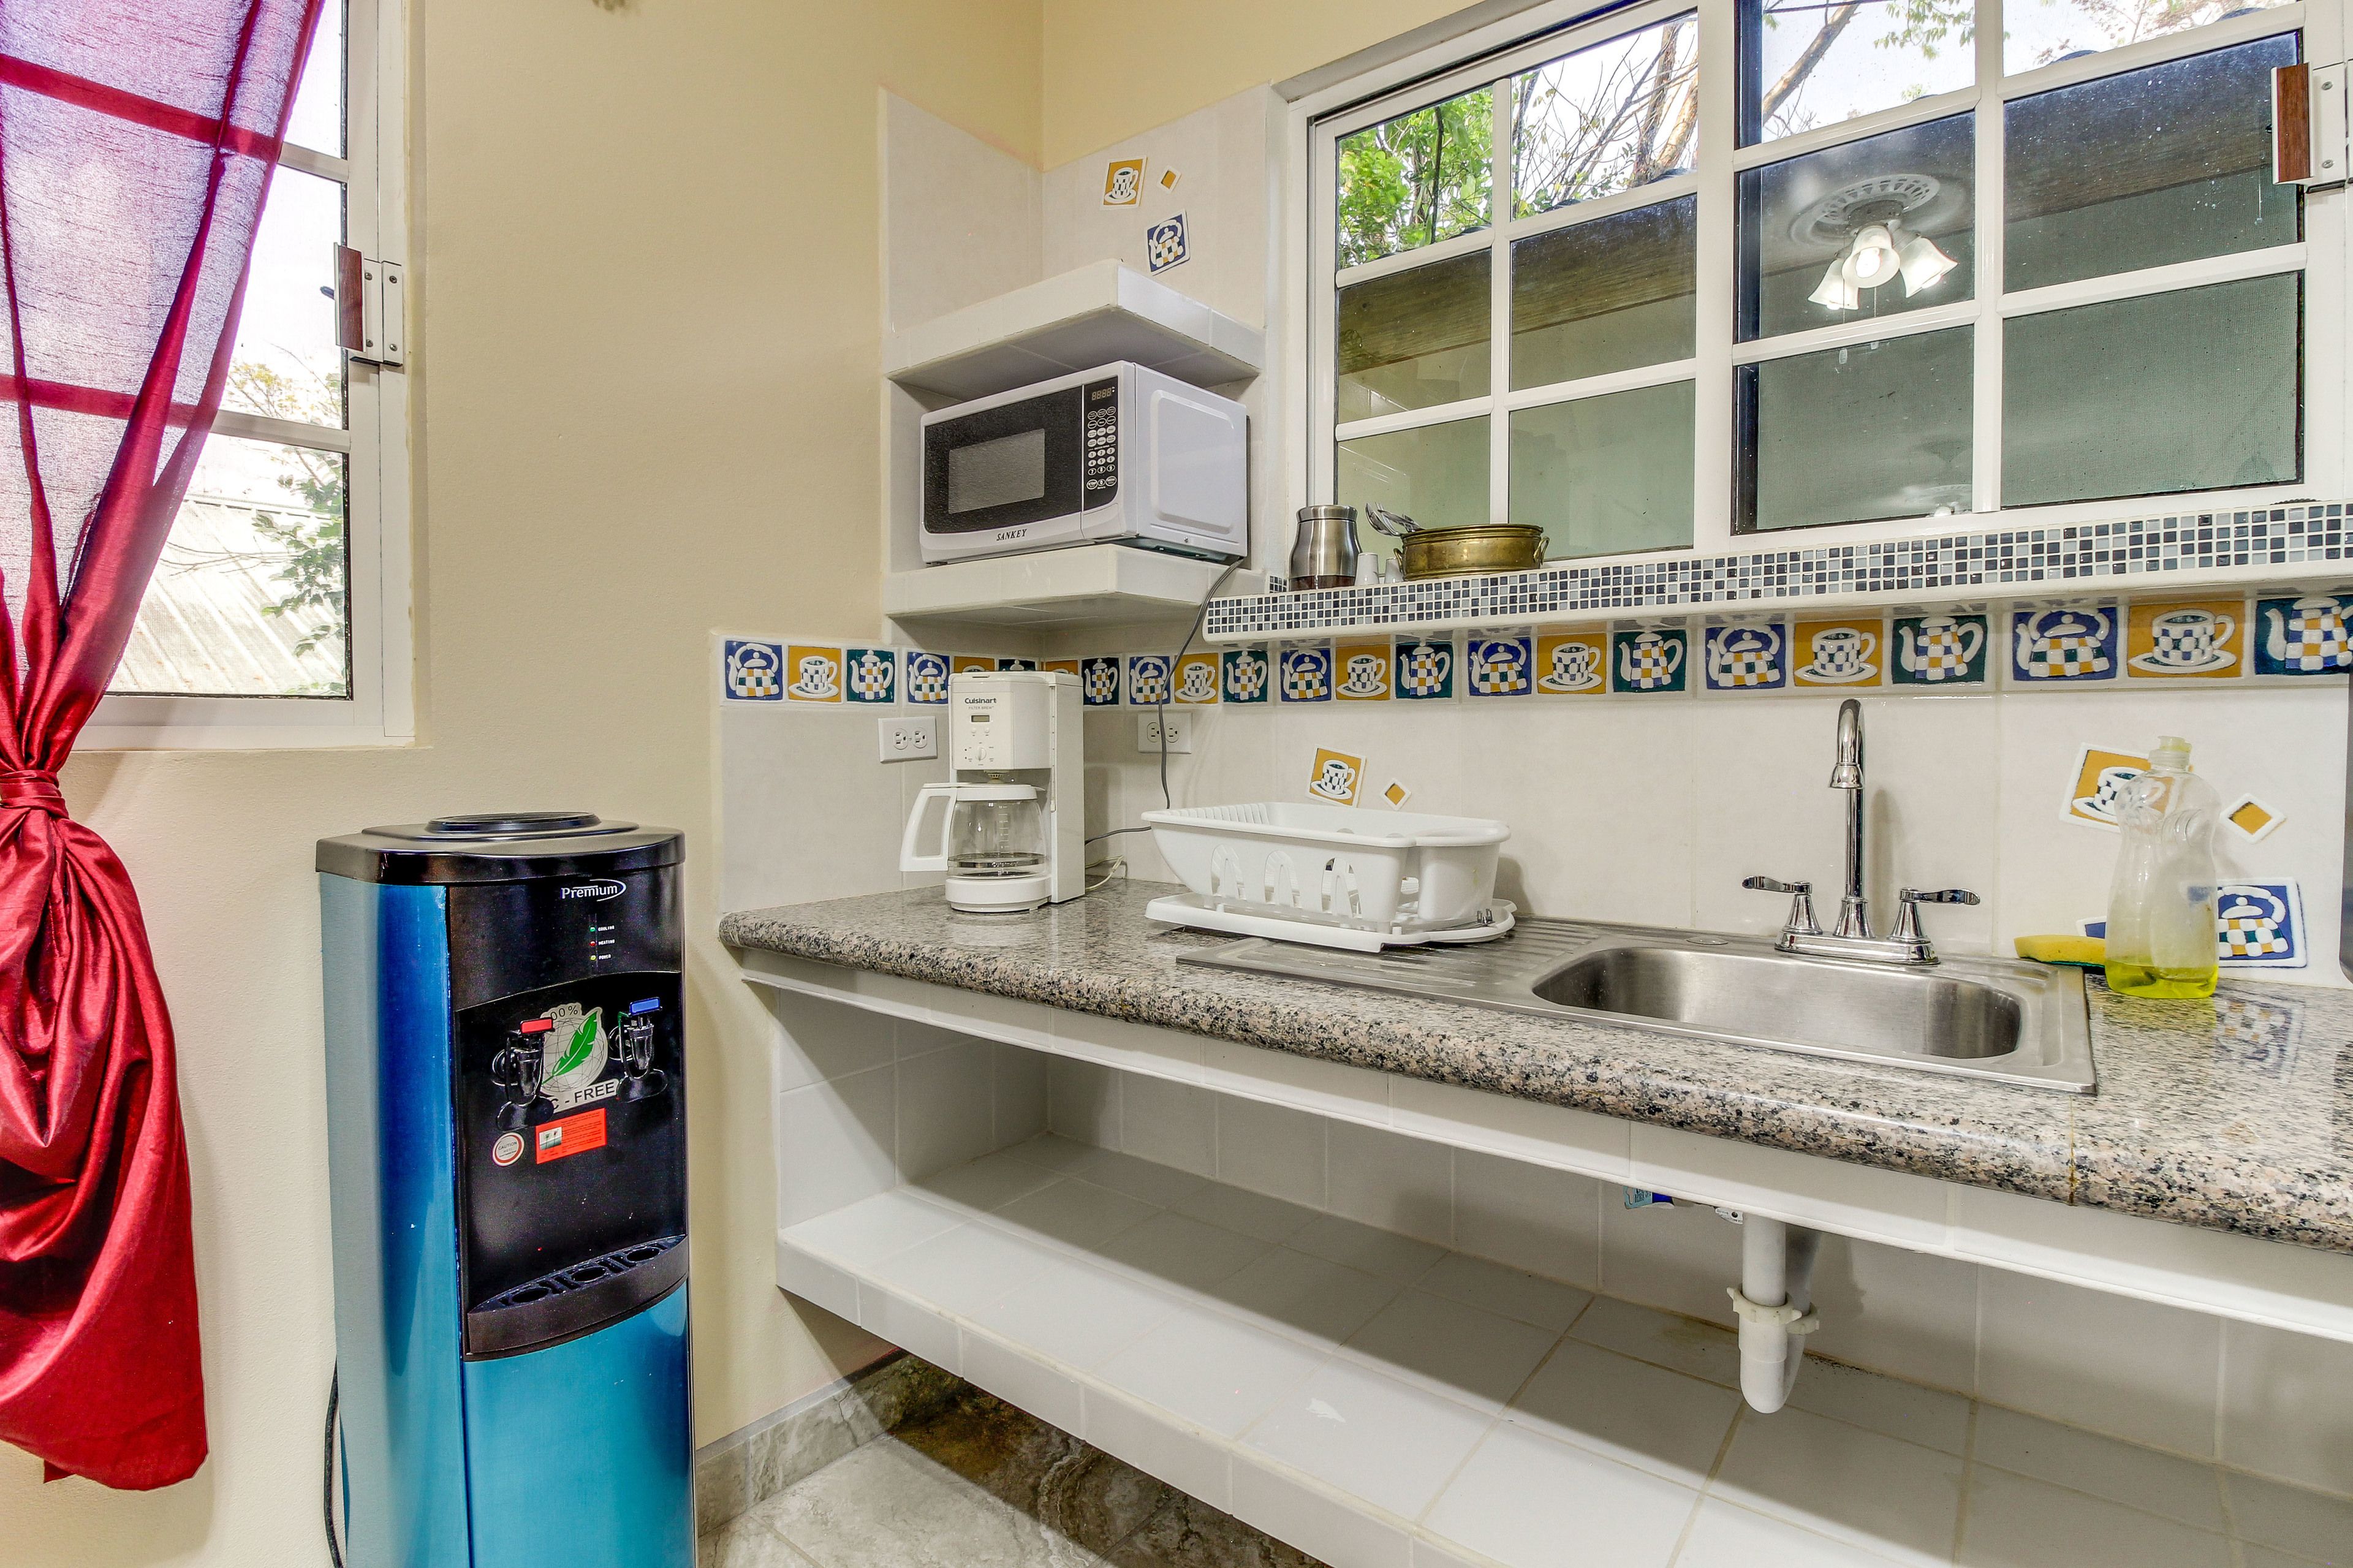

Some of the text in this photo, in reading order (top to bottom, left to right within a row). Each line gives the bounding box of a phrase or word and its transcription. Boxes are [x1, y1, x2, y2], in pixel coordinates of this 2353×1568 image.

[996, 529, 1028, 541] SANKEY
[561, 885, 618, 899] Premium
[550, 1005, 578, 1020] 00%
[574, 1082, 615, 1103] FREE
[498, 1142, 517, 1151] CAUTION
